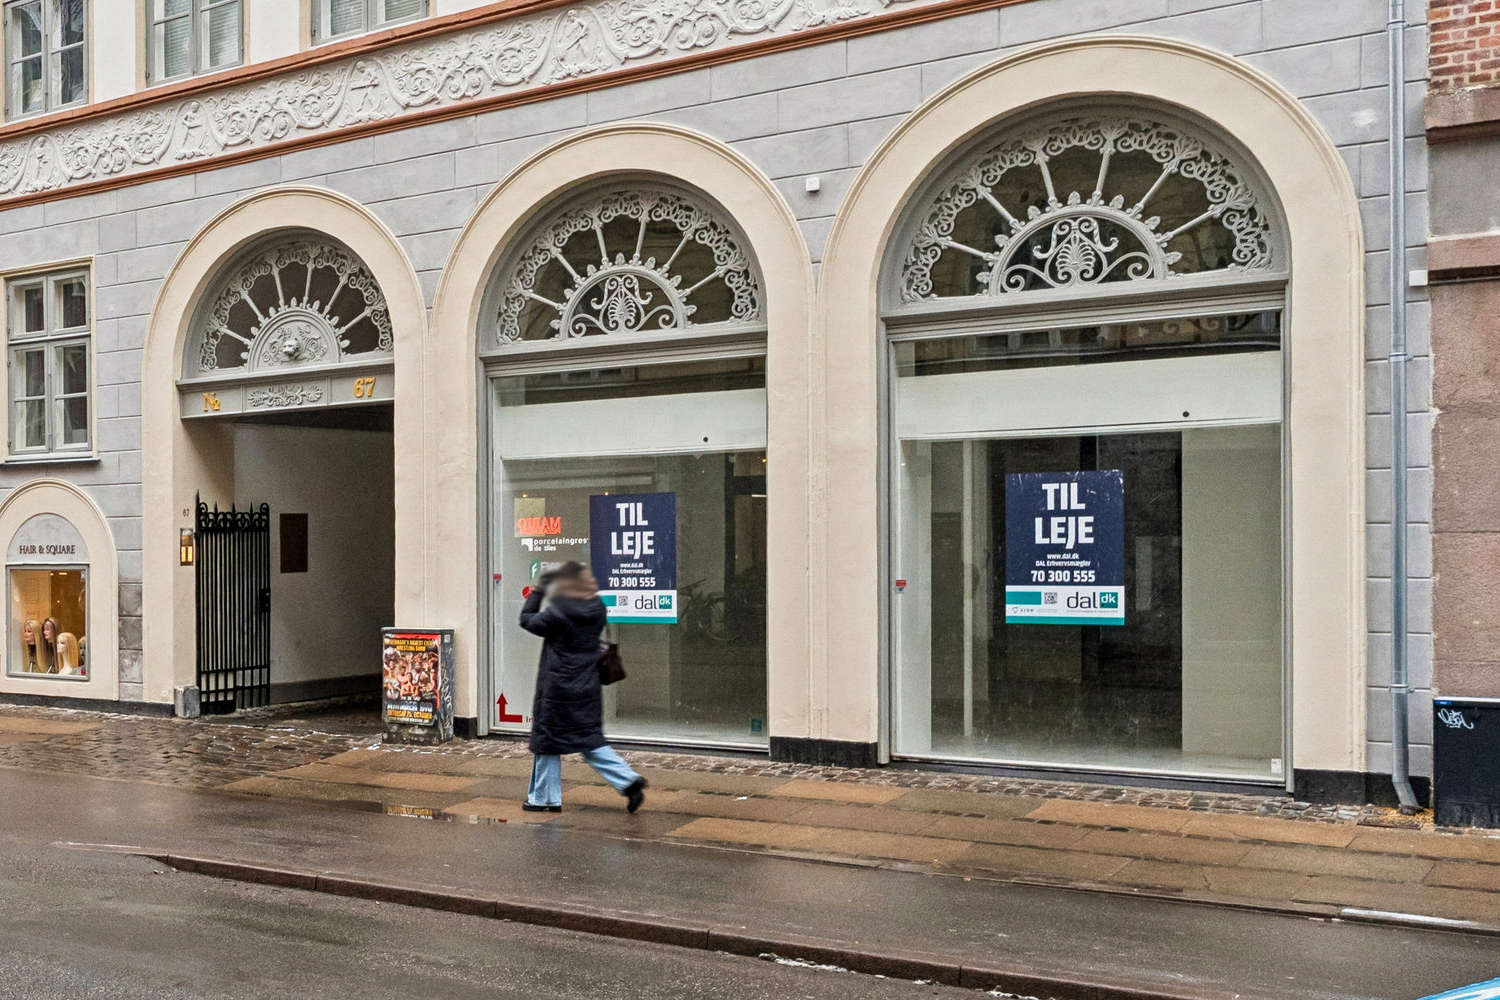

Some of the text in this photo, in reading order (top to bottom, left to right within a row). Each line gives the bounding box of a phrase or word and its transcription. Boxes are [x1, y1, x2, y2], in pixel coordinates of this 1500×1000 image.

[353, 376, 376, 398] 67
[1041, 482, 1086, 511] TIL
[615, 502, 649, 527] TIL
[533, 537, 588, 546] porcelaingres
[1035, 516, 1094, 550] LEJE
[19, 544, 76, 556] HAIR & SQUARE
[610, 530, 655, 560] LEJE
[1046, 559, 1092, 568] Erhvervsmægler
[608, 577, 656, 588] 70 300 555
[1030, 570, 1096, 583] 70 300 555
[634, 594, 671, 610] dal dk
[1066, 591, 1116, 609] dal dk
